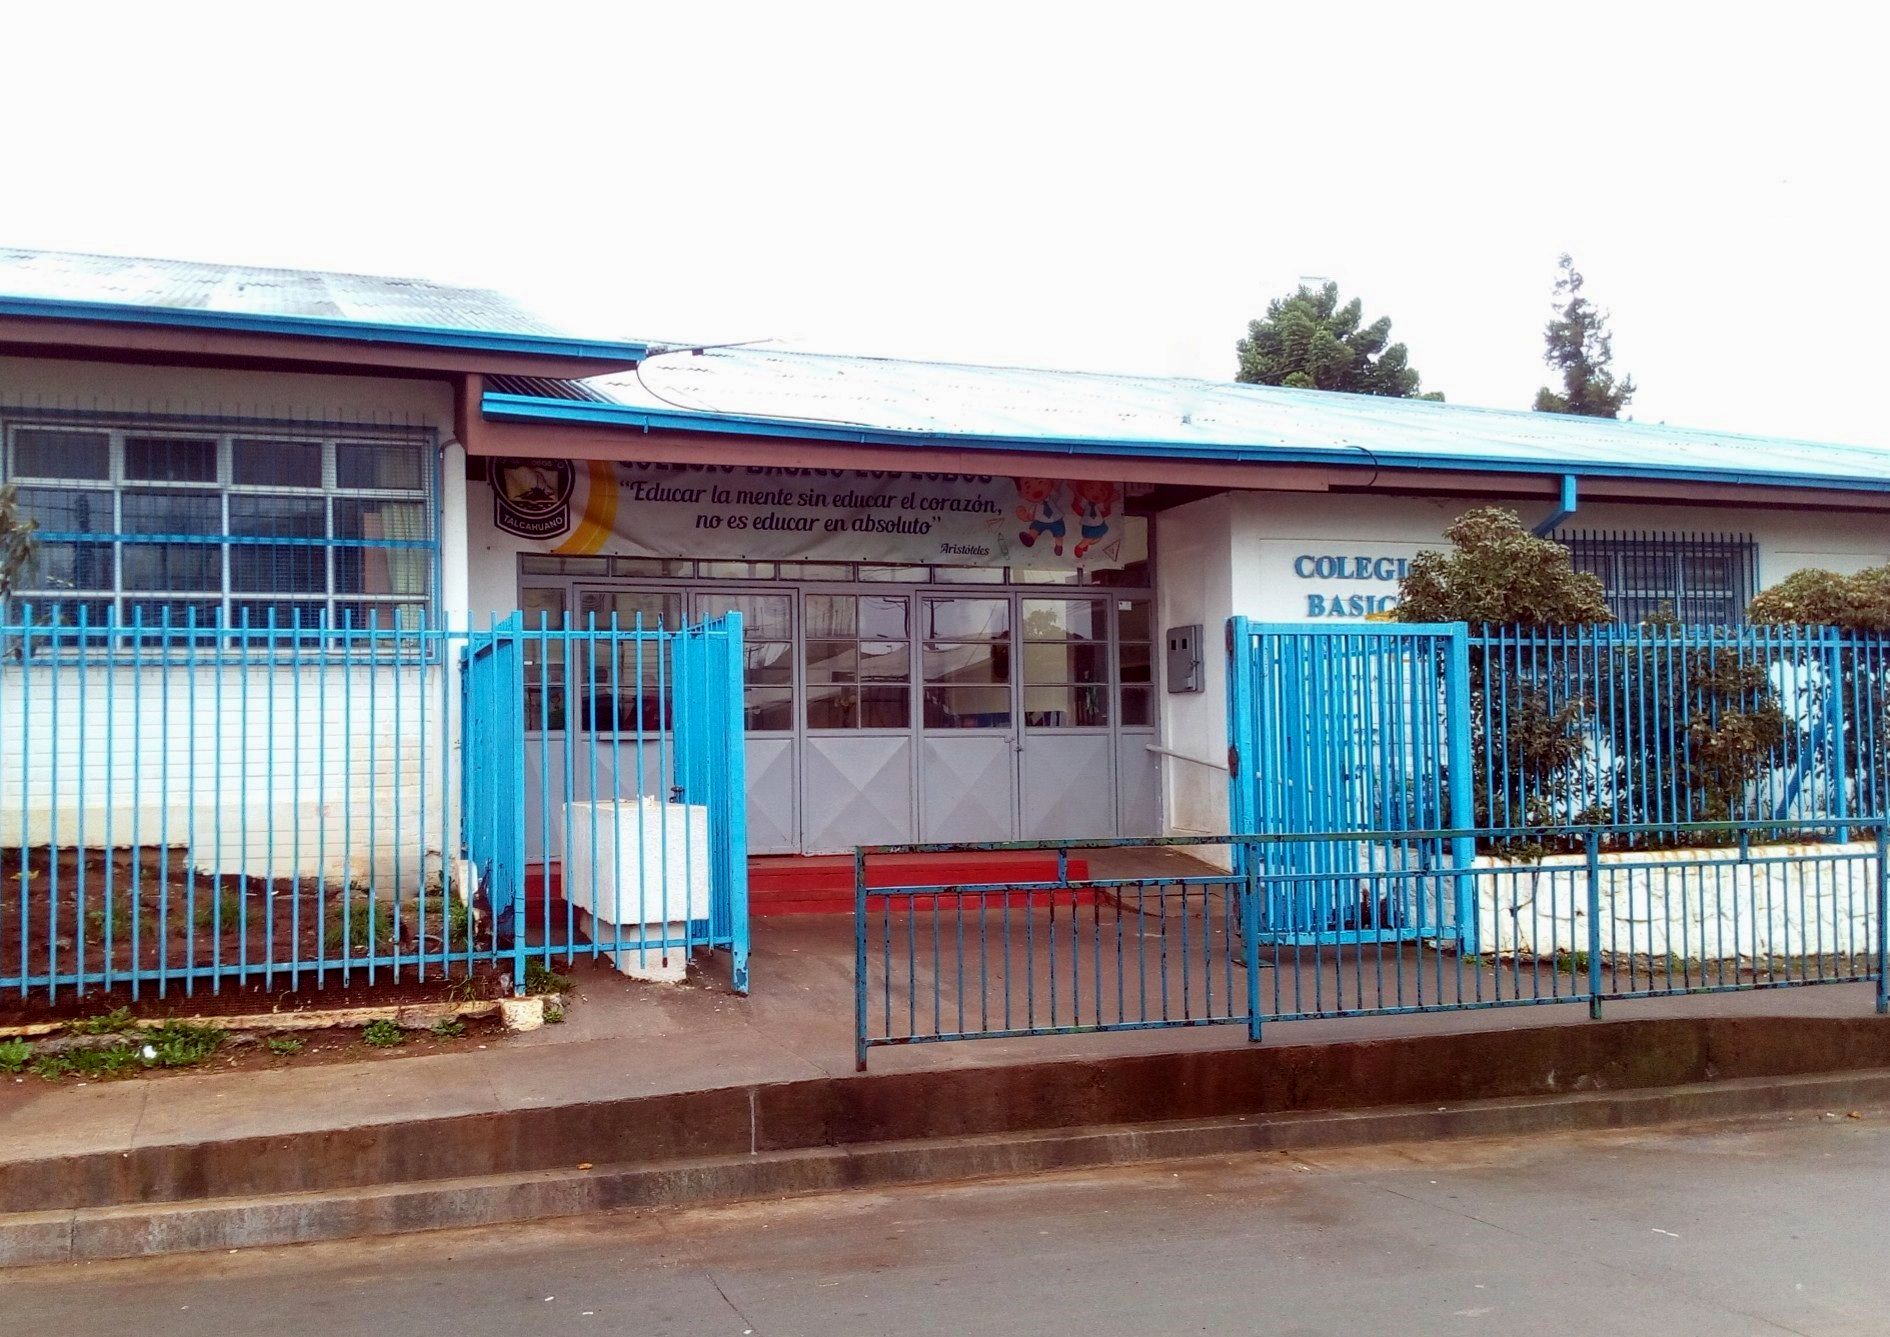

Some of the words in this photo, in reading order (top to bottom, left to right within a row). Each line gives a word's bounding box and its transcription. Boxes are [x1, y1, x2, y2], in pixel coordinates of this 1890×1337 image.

[711, 482, 732, 505] la
[736, 487, 793, 507] mente
[797, 488, 828, 508] sin
[832, 491, 896, 510] educar
[900, 491, 915, 511] el
[919, 494, 1003, 516] corazón,
[503, 514, 564, 532] TALCAHUANO
[695, 512, 720, 529] no
[726, 513, 748, 530] es
[752, 511, 819, 532] educar
[824, 516, 848, 533] en
[940, 543, 990, 556] Aristóteles
[1294, 555, 1412, 581] COLEGI
[1307, 594, 1399, 617] BASIC
